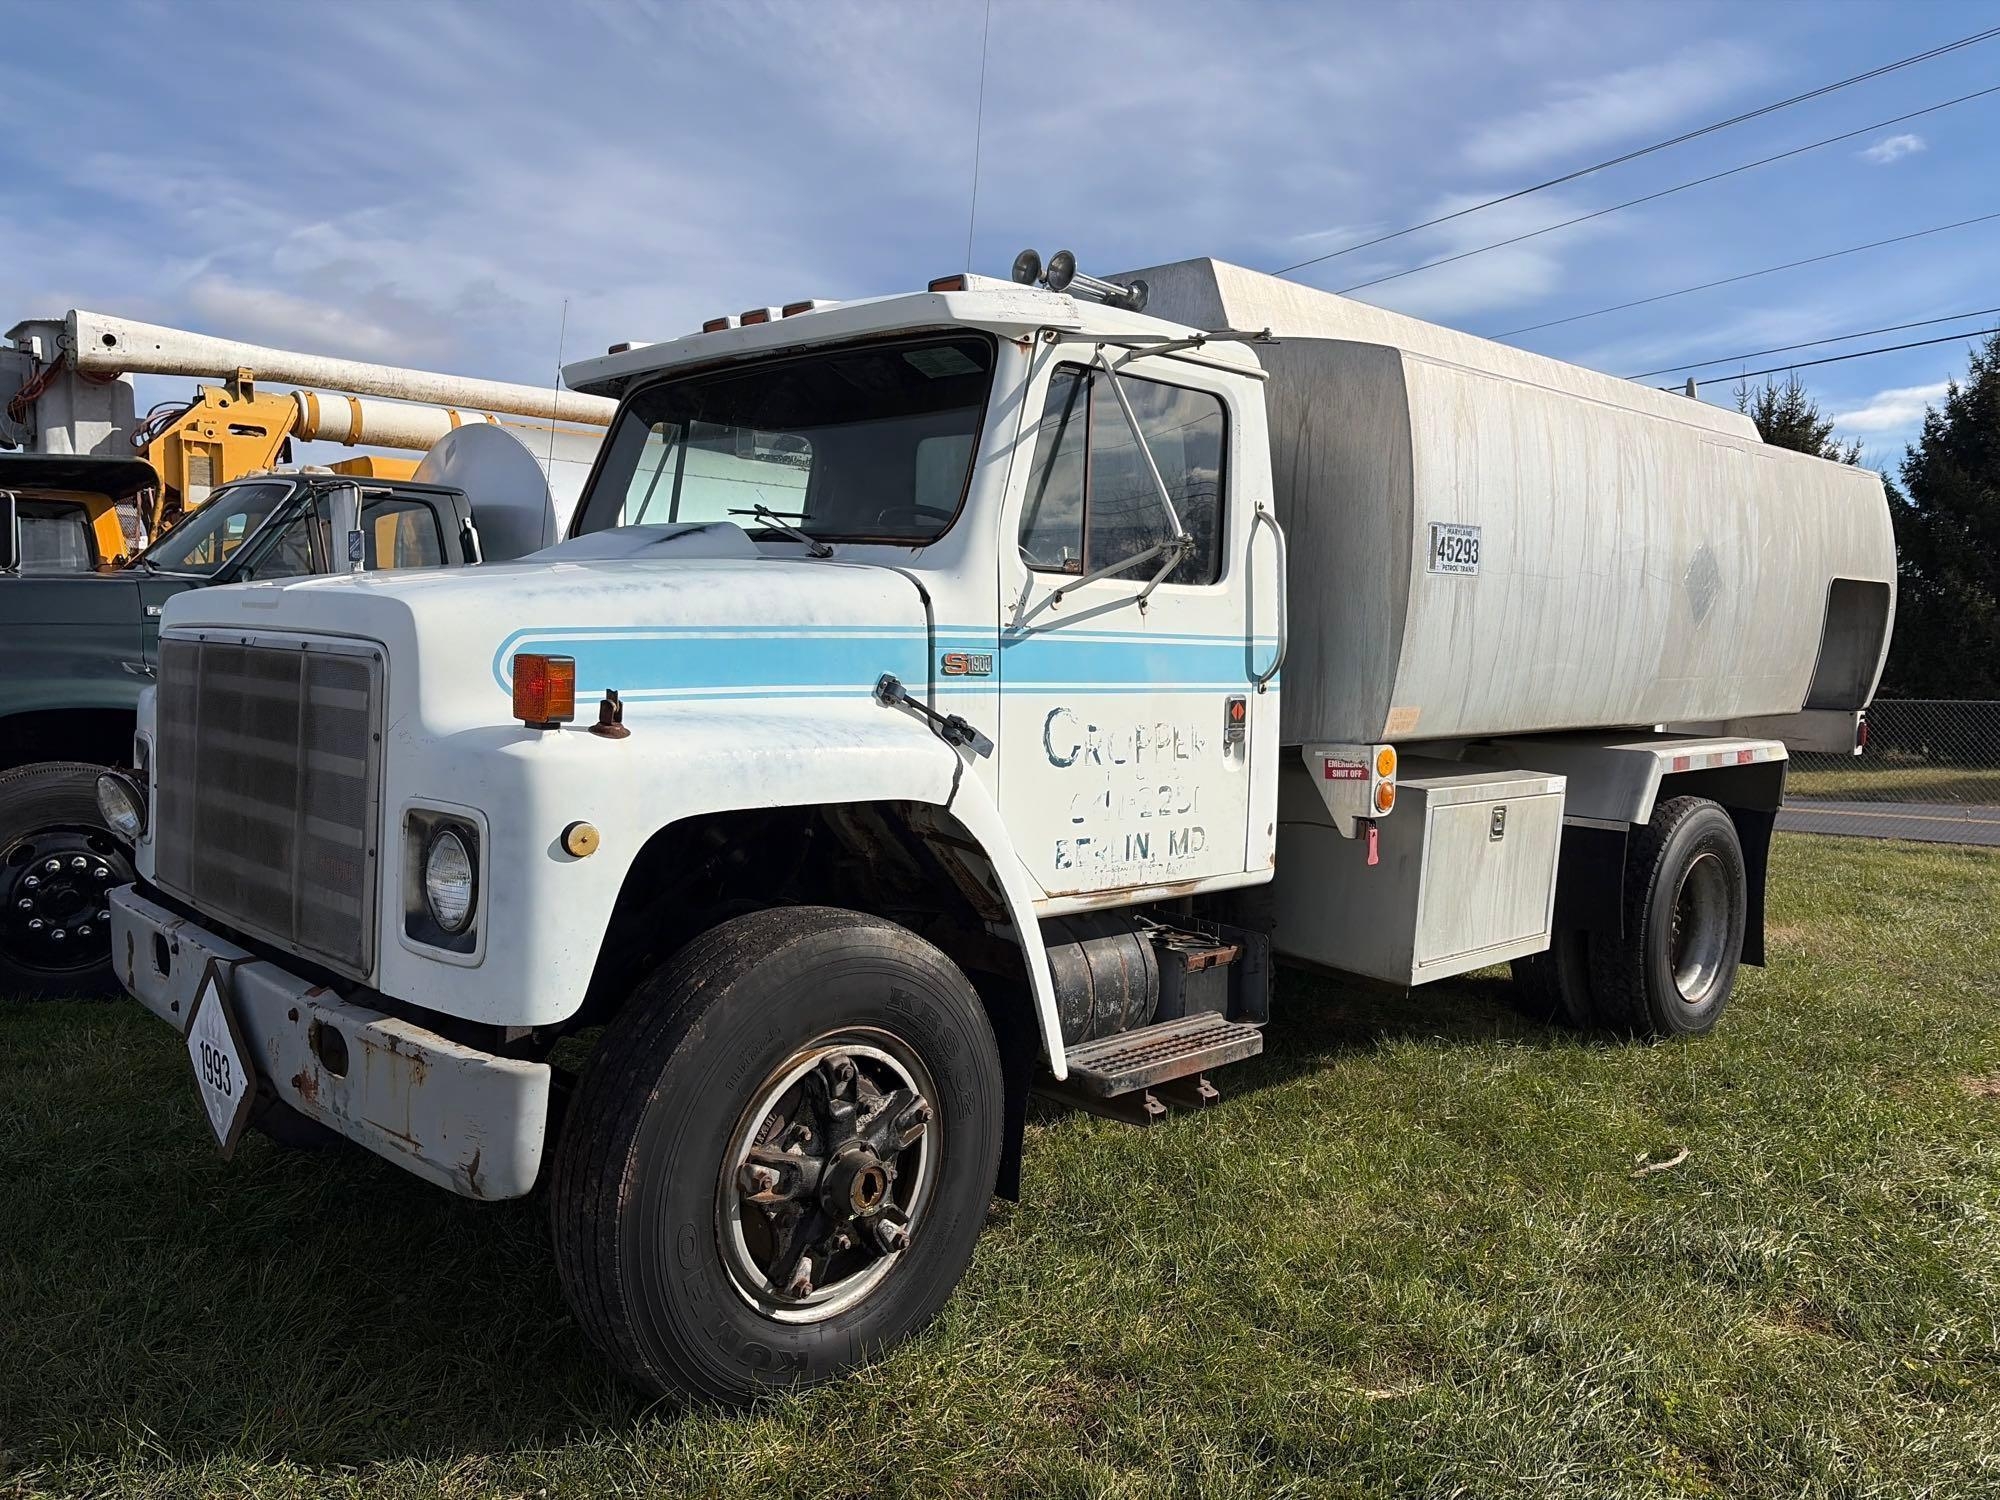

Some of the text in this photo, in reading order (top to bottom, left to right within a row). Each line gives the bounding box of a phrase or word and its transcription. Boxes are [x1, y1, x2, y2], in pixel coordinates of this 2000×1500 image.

[1447, 528, 1473, 537] MARYLAND
[1437, 536, 1479, 564] 45293
[1442, 564, 1459, 572] PETROL
[1332, 769, 1362, 778] SHUT OFF
[200, 1040, 232, 1097] 1993
